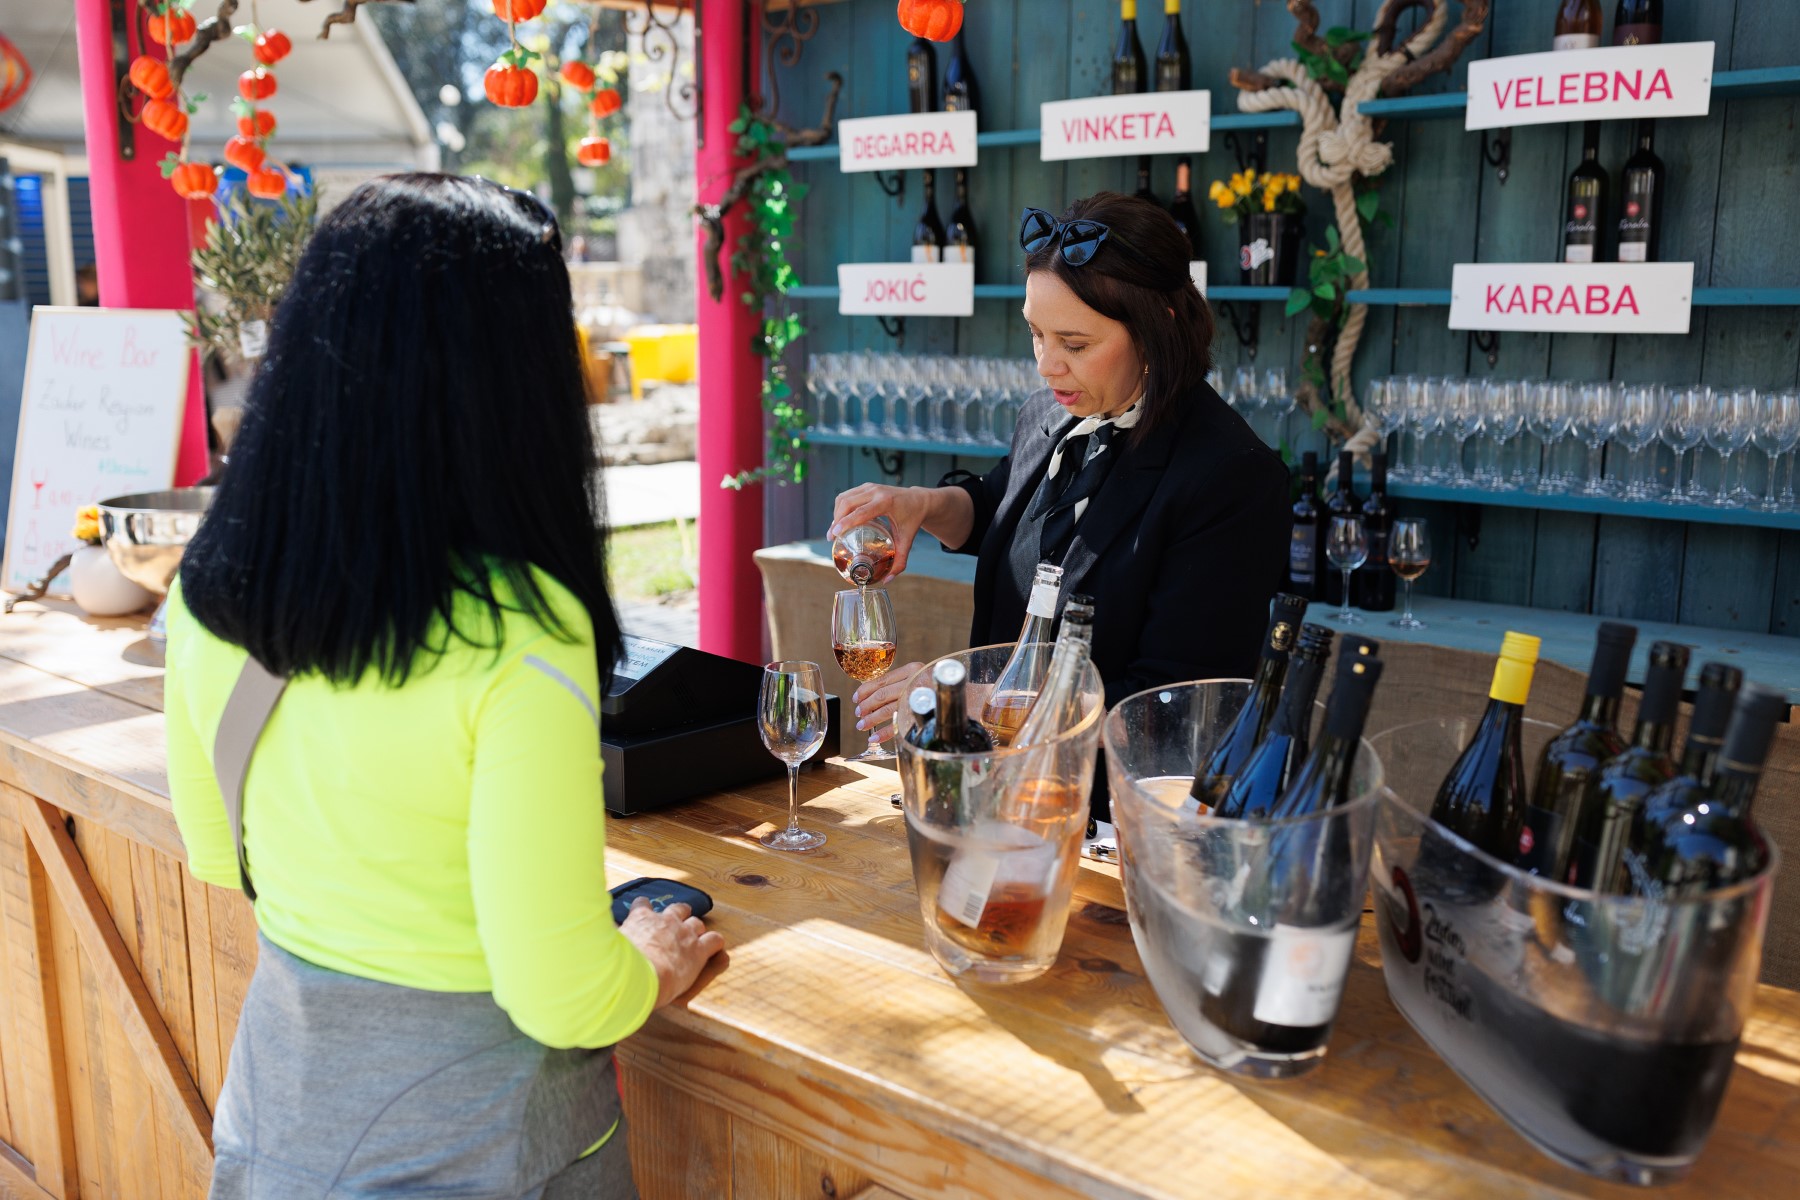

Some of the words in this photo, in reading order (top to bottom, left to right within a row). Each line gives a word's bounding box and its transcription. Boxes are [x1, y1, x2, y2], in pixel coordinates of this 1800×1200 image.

[1493, 67, 1674, 110] VELEBNA
[1062, 112, 1176, 143] VINKETA
[853, 130, 956, 160] DEGARRA
[863, 273, 927, 303] JOKIĆ
[1484, 284, 1641, 316] KARABA
[50, 323, 107, 369] Wine
[119, 324, 160, 369] Bar
